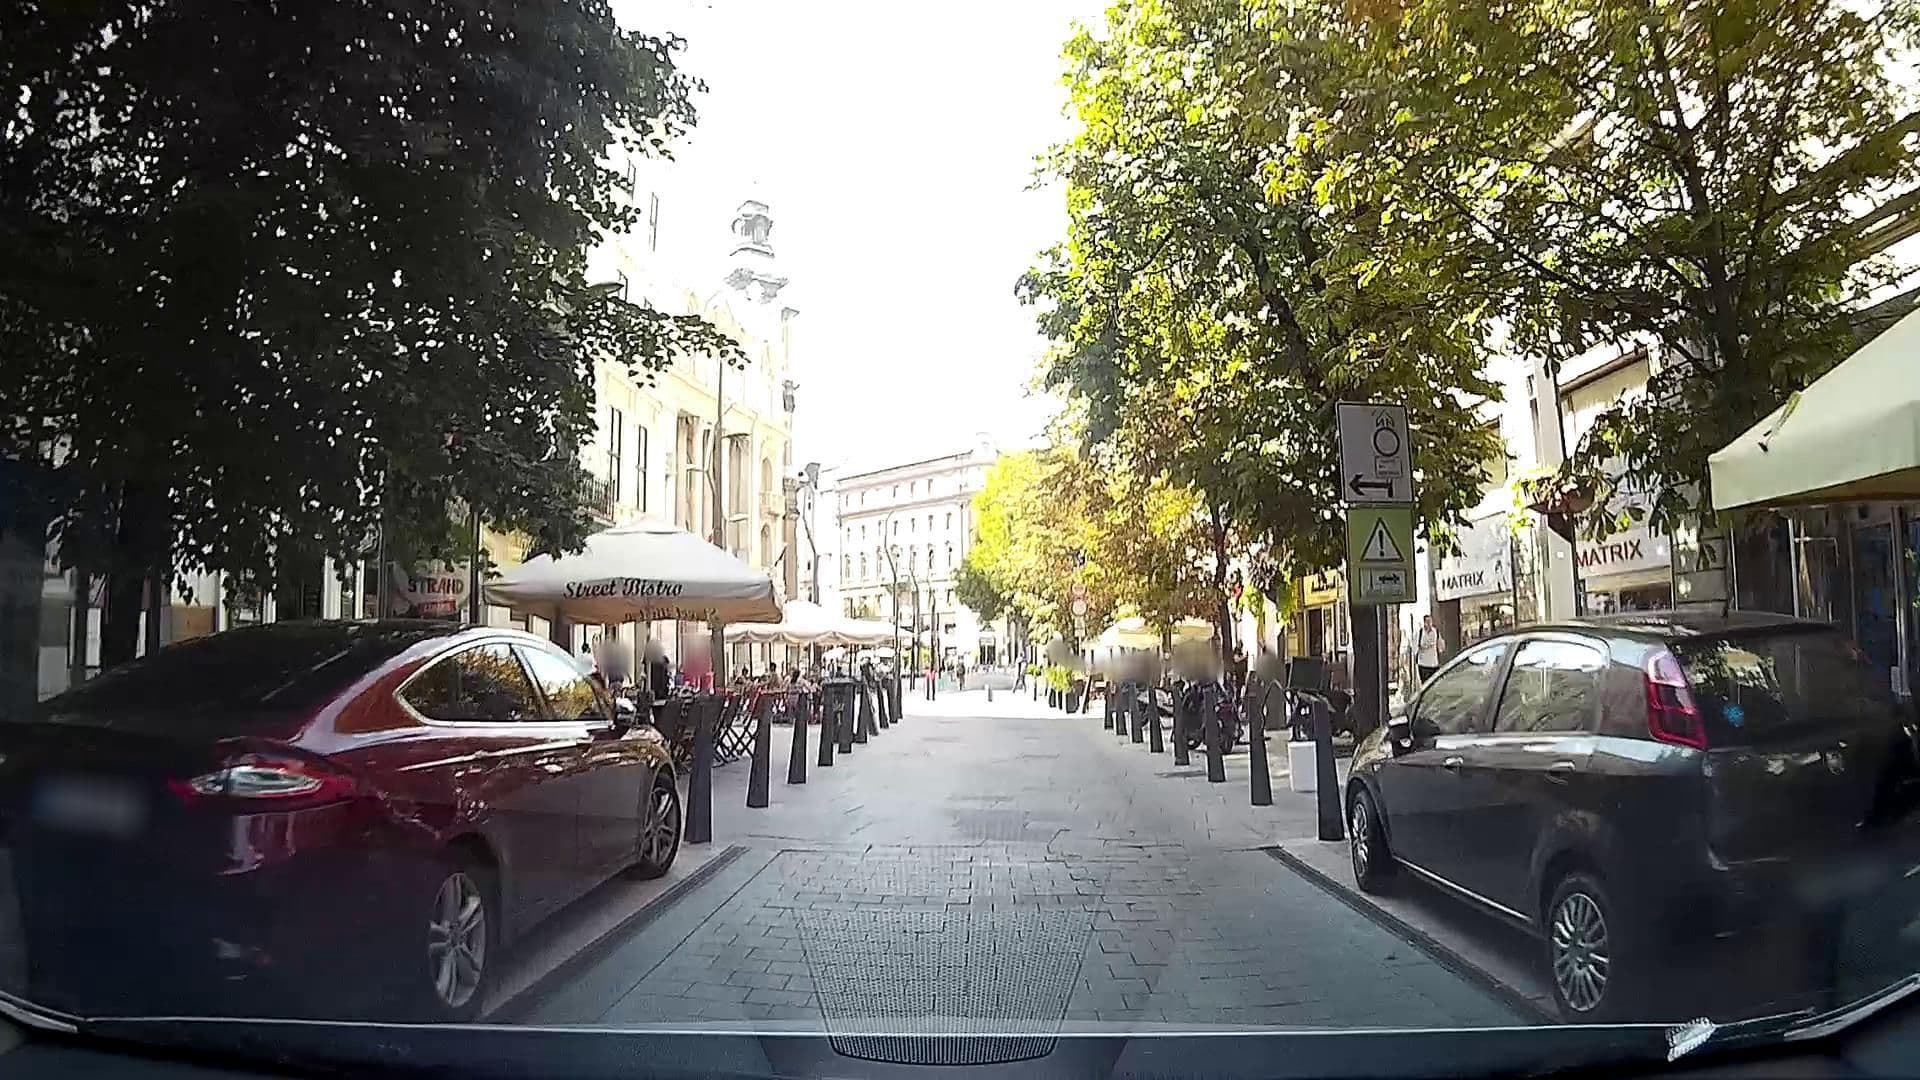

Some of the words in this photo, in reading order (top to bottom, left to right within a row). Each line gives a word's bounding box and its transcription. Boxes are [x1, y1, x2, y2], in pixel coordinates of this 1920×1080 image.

[1576, 539, 1643, 568] MATRIX
[562, 579, 617, 600] Street
[623, 577, 683, 597] Bistro
[1442, 570, 1484, 590] MATRIX
